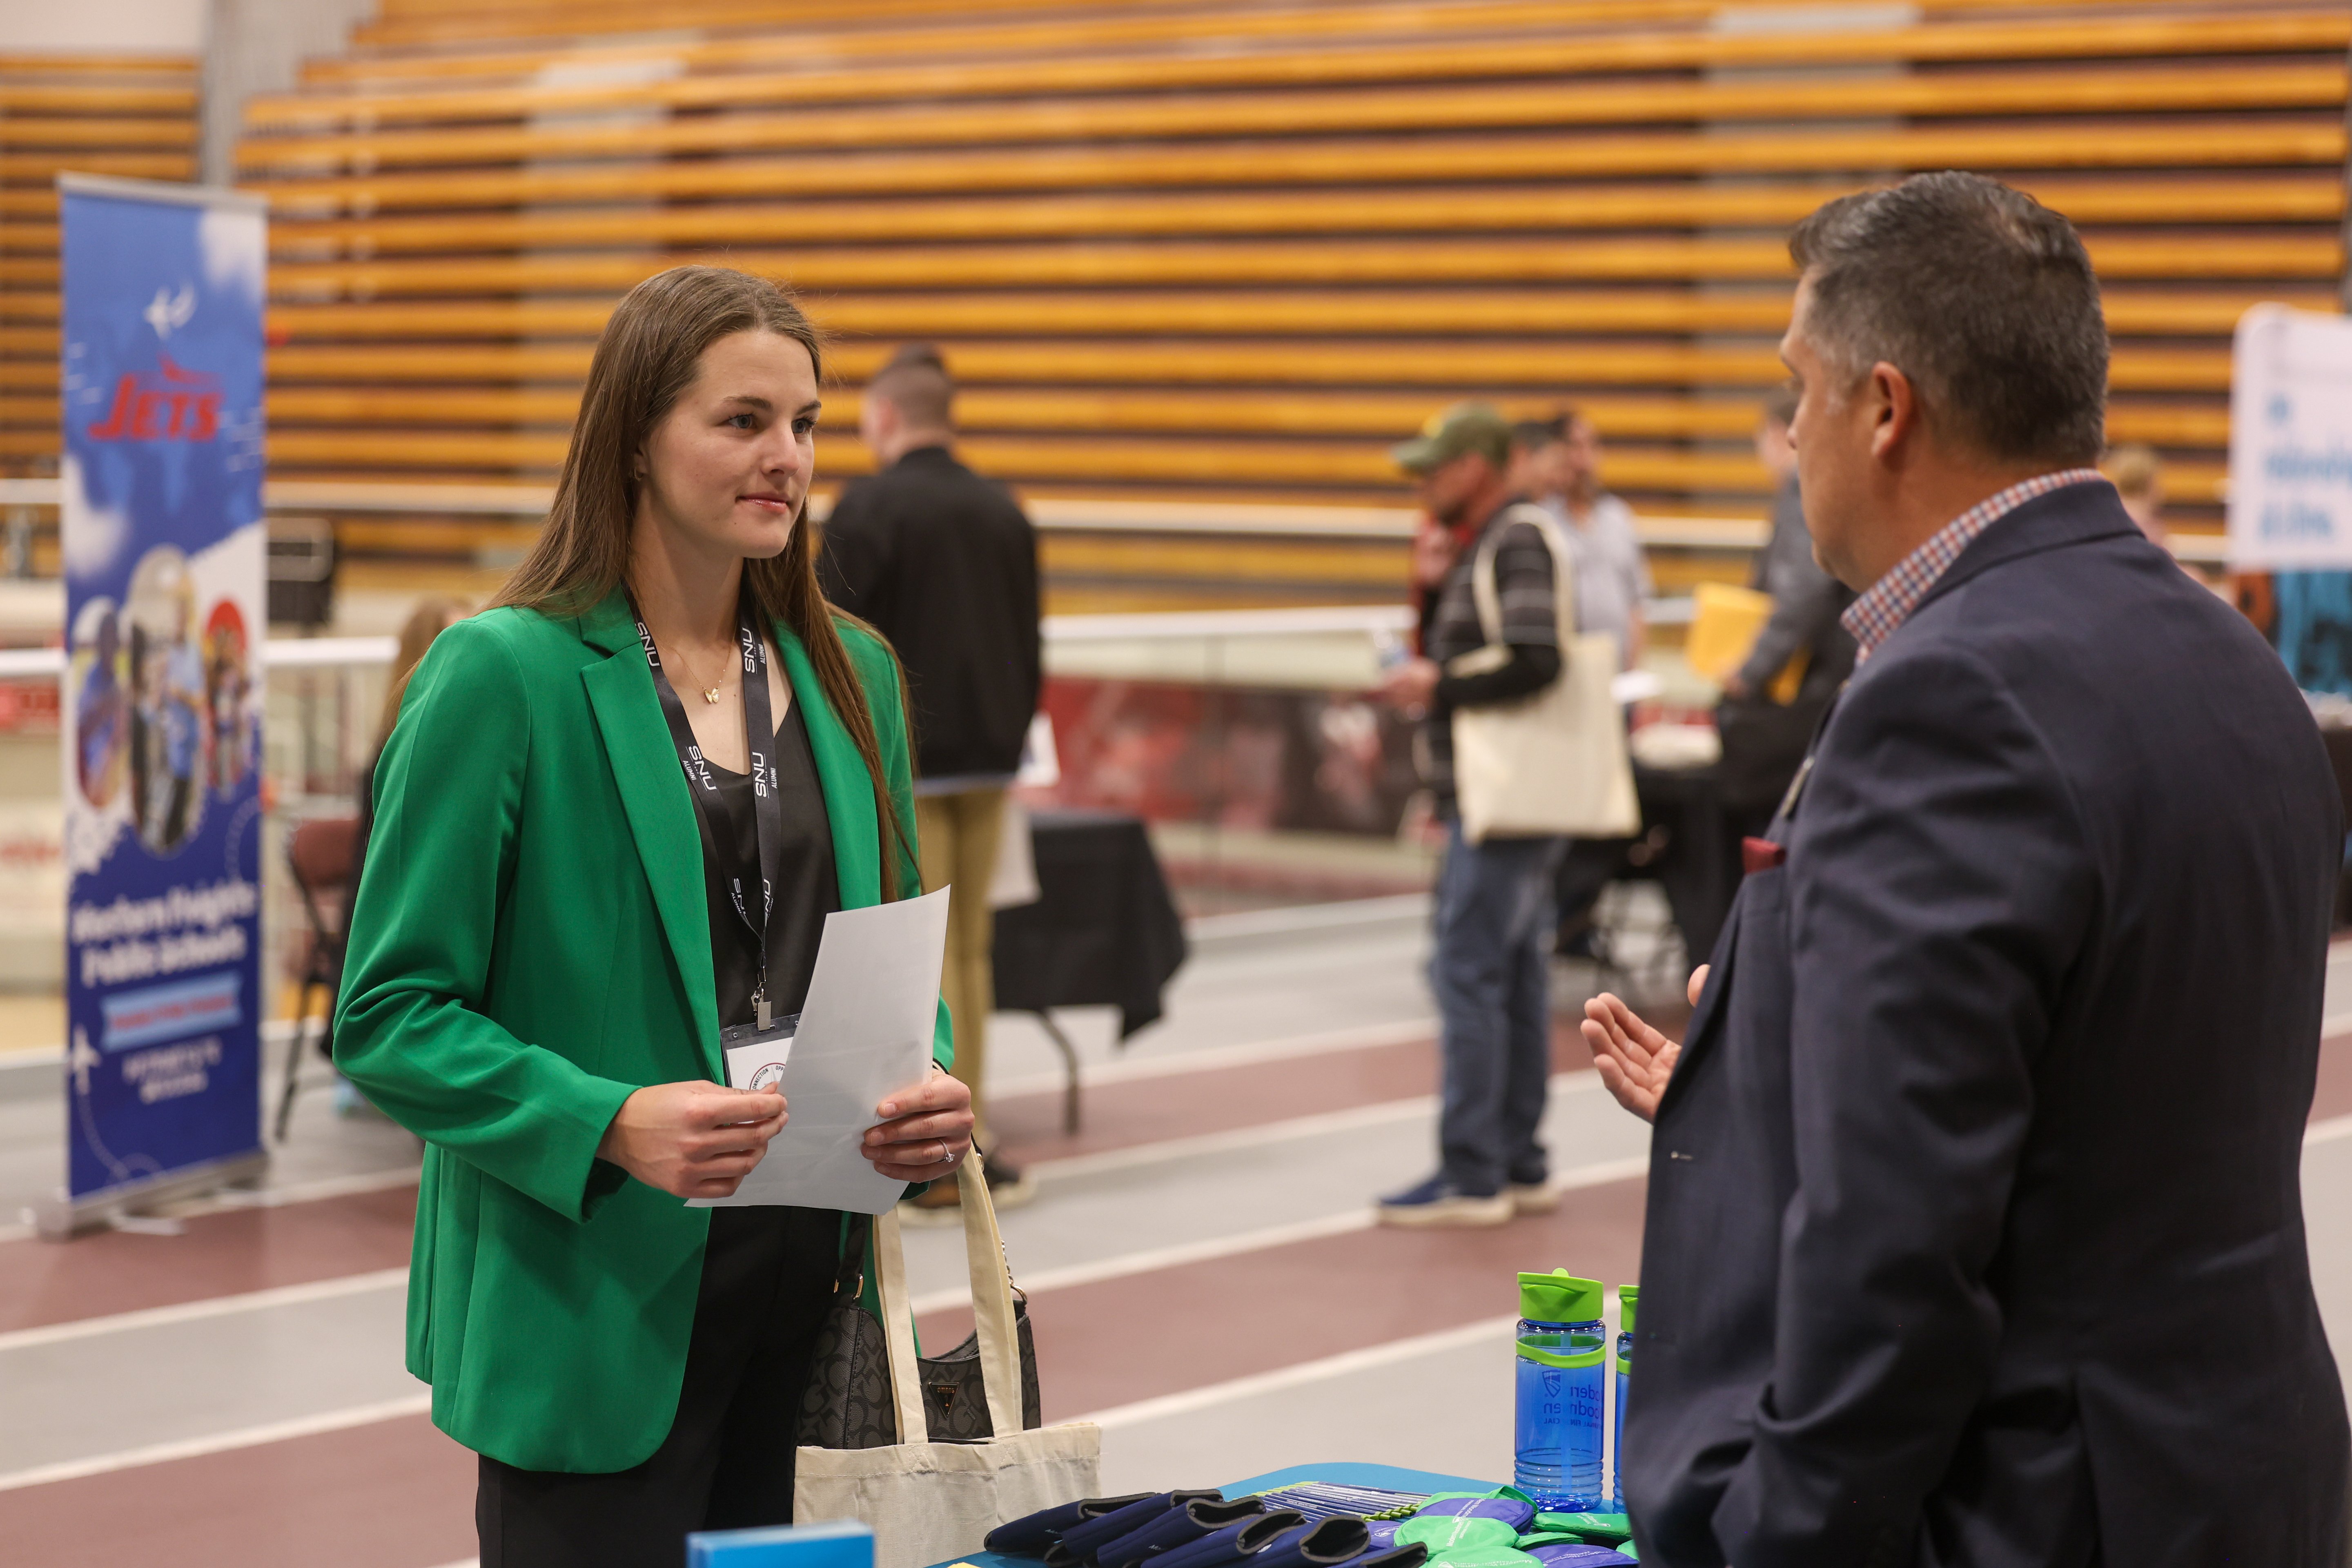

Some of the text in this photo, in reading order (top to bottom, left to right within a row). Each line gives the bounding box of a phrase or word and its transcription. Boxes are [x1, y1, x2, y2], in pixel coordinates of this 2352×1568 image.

[635, 622, 660, 666] SNU
[742, 627, 755, 673] SNU
[758, 644, 766, 664] ALUMNI
[682, 760, 697, 780] ALUMNI
[688, 746, 717, 790] SNU
[752, 751, 767, 797] SNU
[731, 892, 742, 913] ALUMNI
[752, 1067, 768, 1091] ONNECTION
